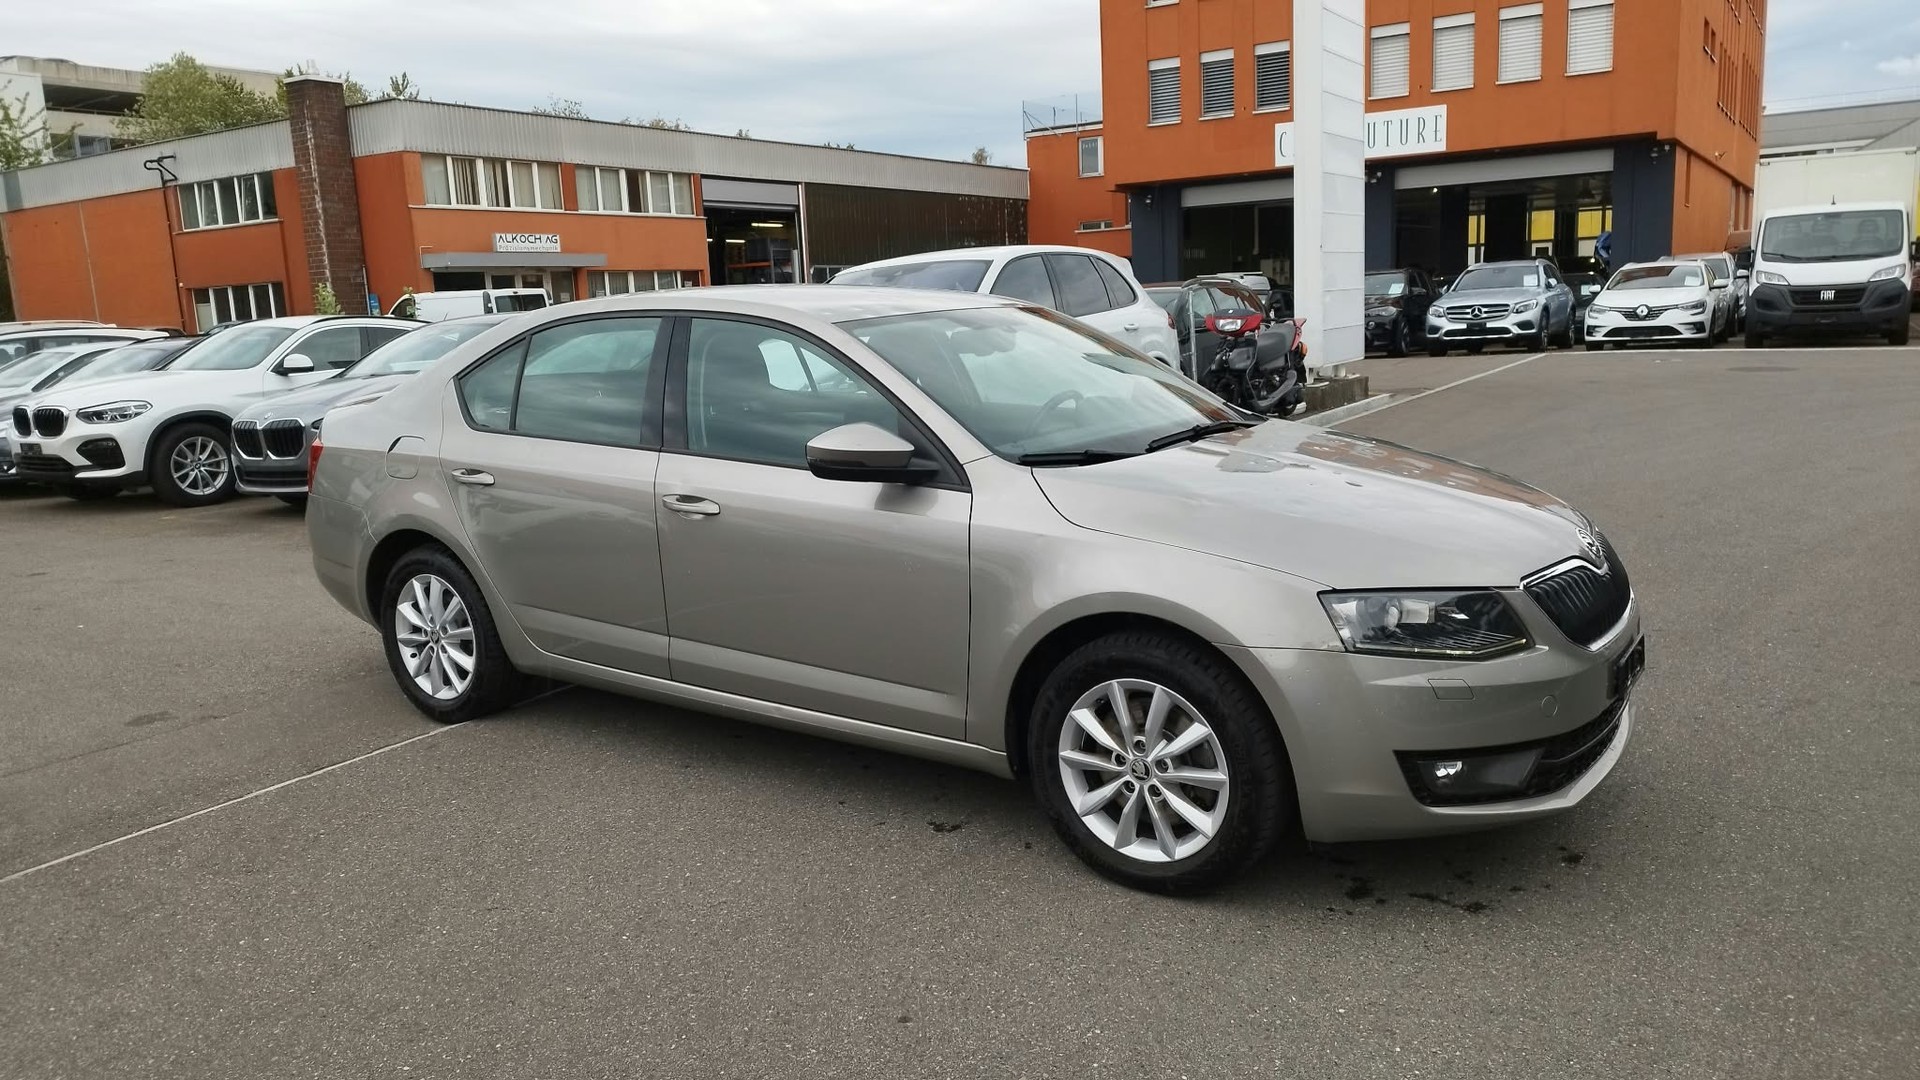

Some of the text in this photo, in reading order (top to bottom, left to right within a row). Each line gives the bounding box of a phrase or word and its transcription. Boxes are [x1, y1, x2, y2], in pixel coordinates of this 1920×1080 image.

[1367, 114, 1443, 149] UTURE
[498, 234, 558, 244] ALKOCH AG
[1820, 290, 1836, 301] FIAT
